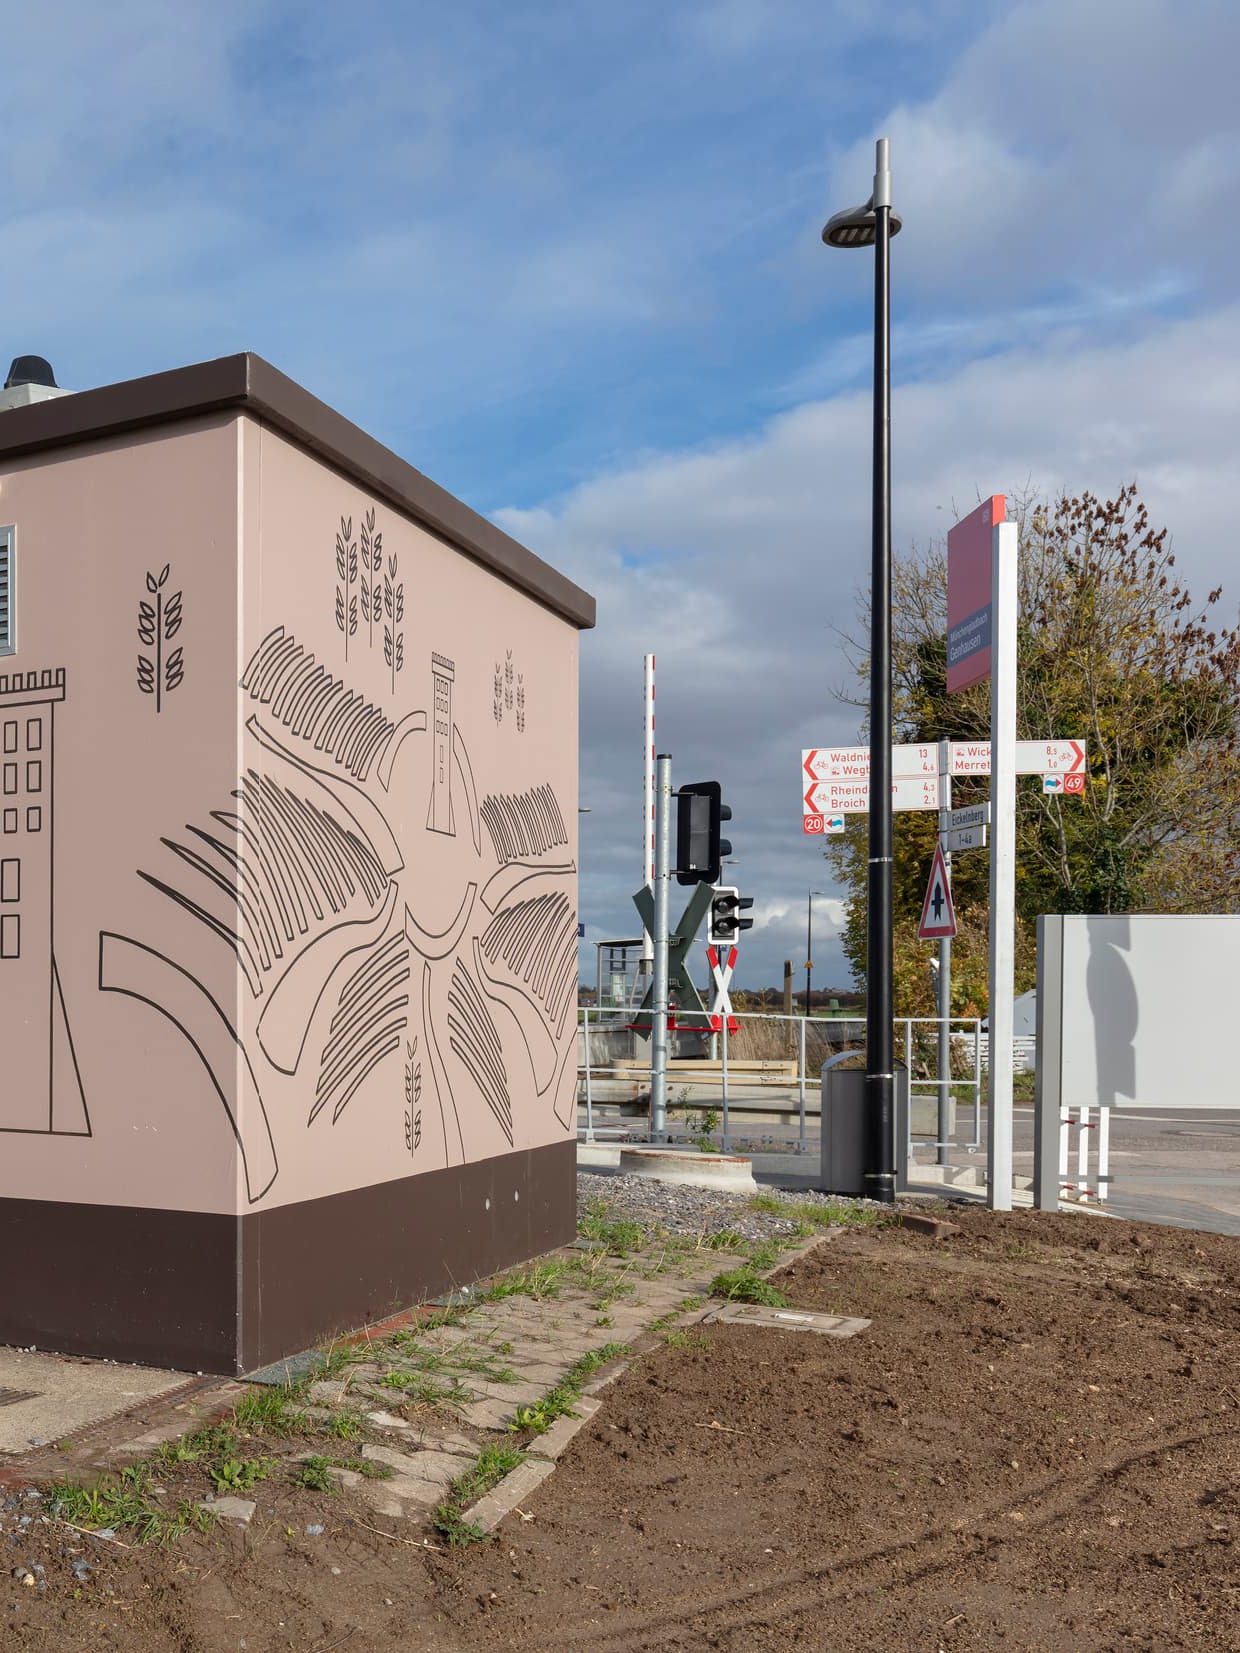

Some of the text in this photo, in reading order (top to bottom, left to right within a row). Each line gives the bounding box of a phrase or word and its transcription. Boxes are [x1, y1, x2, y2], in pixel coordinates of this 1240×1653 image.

[950, 634, 981, 661] Genhausen
[831, 749, 928, 762] Waldnie 13
[968, 747, 992, 756] Wick
[955, 760, 992, 770] Merret
[1067, 777, 1081, 788] 49
[831, 784, 898, 795] Rheindn
[831, 799, 866, 808] Broich
[807, 819, 821, 829] 20
